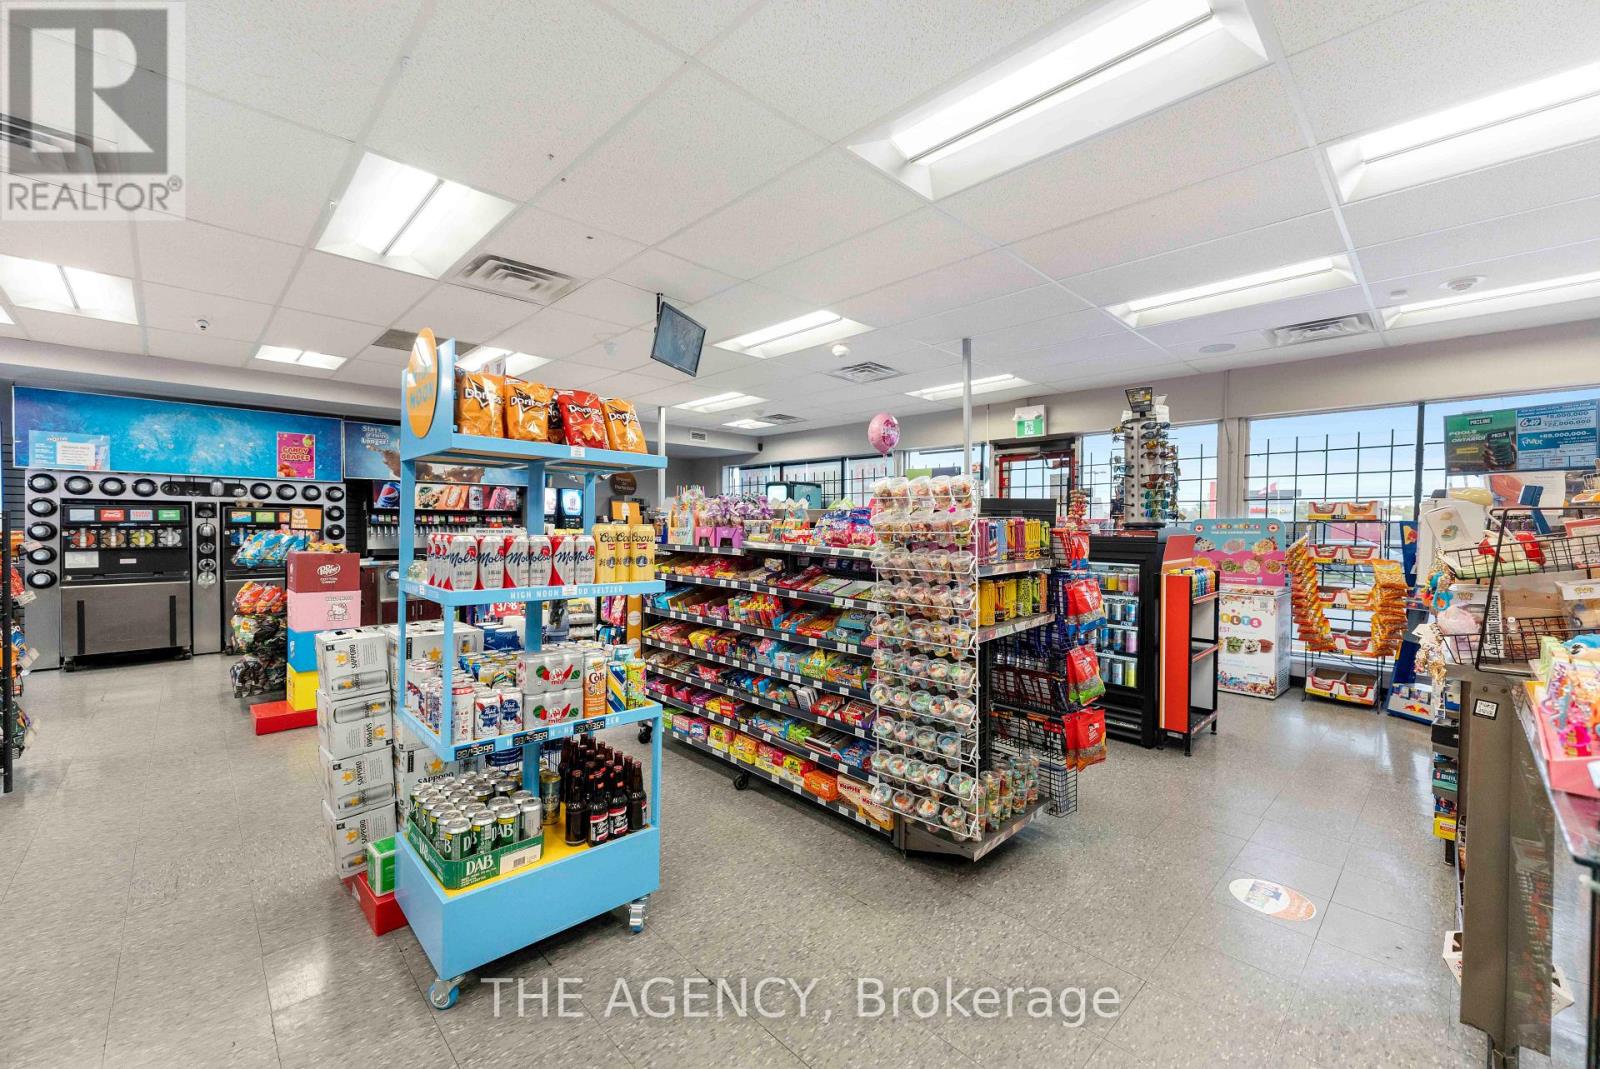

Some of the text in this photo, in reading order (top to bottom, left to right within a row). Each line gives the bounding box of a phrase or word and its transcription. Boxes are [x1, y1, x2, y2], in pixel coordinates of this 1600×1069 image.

[281, 454, 311, 462] GRAPES
[282, 446, 310, 455] CANDY
[510, 591, 532, 600] HIGH
[536, 589, 560, 598] NOON
[592, 584, 624, 594] SELTZER
[1221, 613, 1262, 628] ELTS
[349, 643, 359, 669] SAPPORO
[365, 722, 374, 748] SAPPORO
[356, 760, 365, 786] SAPPORO
[359, 819, 368, 845] SAPPORO
[466, 853, 494, 876] DAB
